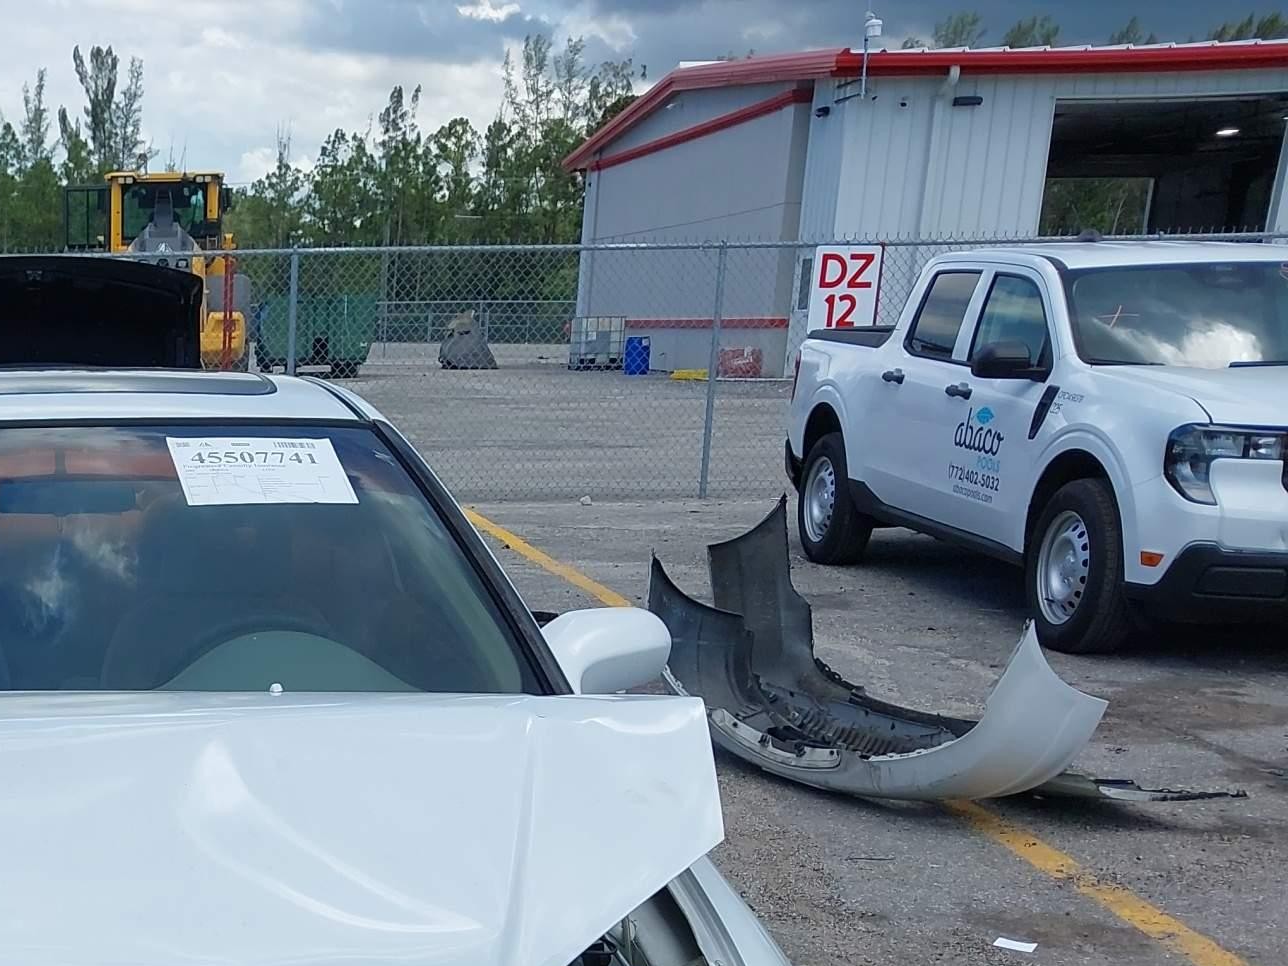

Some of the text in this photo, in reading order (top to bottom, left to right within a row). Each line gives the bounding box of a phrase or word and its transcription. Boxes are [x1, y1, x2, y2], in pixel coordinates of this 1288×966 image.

[819, 253, 875, 289] DZ
[824, 294, 857, 328] 12
[954, 407, 1005, 456] abaco
[191, 451, 320, 465] 45507741
